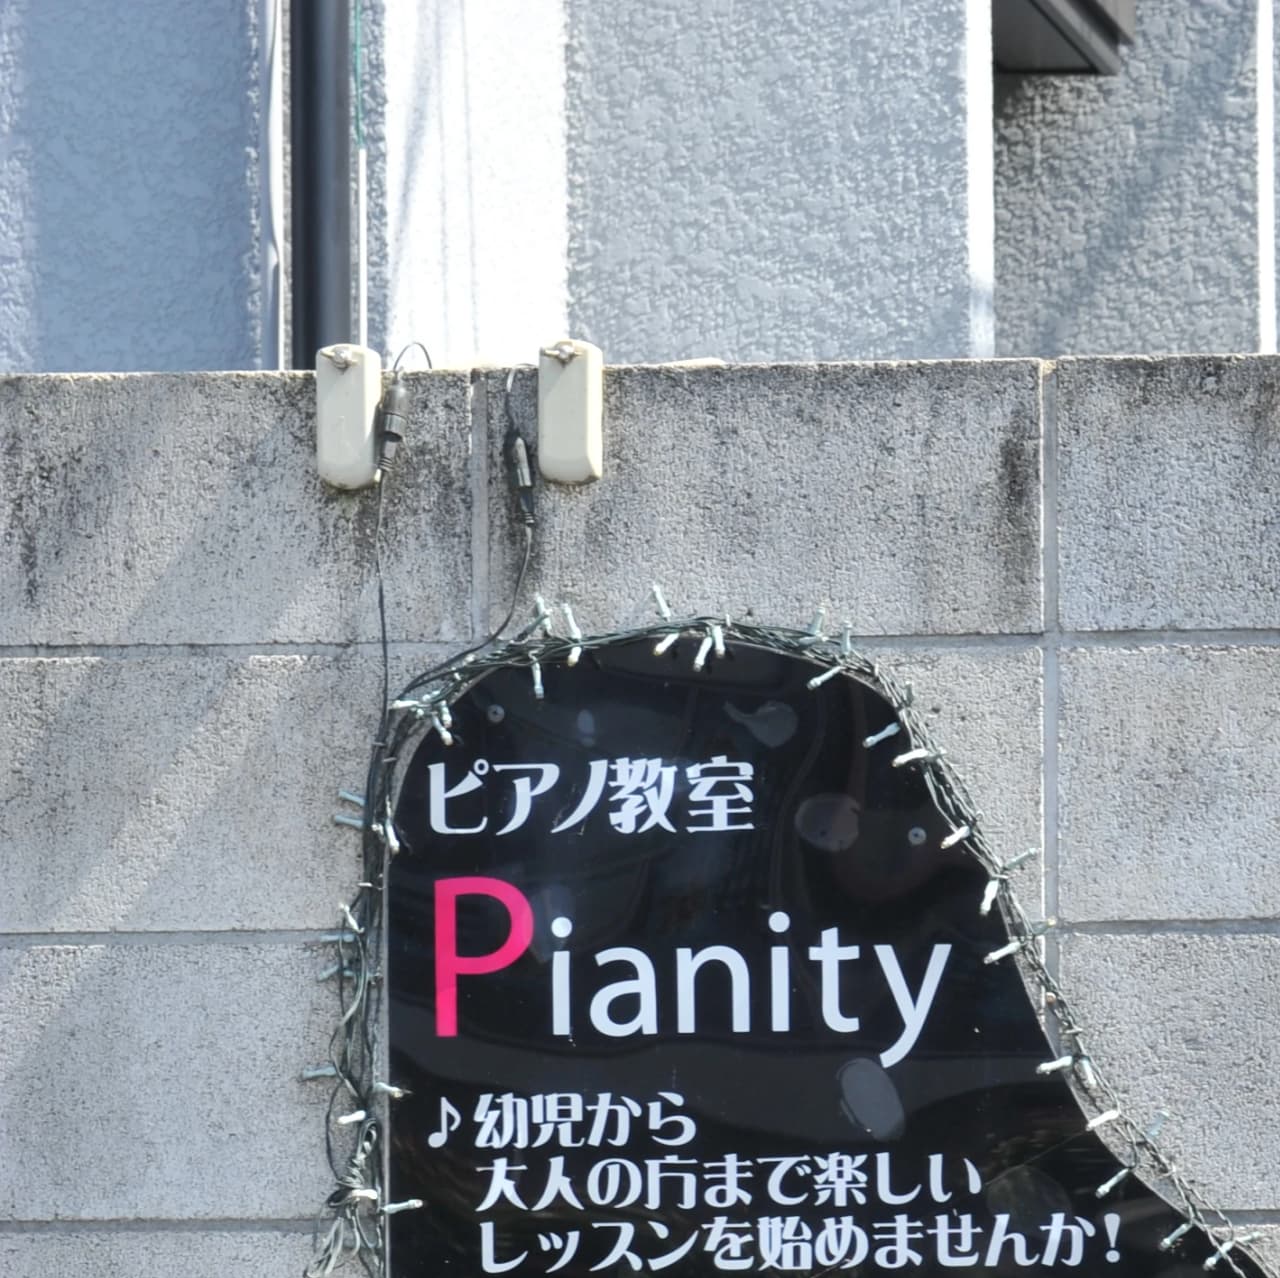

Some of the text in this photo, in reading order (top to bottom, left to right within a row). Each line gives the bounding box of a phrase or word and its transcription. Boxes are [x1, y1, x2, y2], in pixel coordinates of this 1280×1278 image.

[427, 754, 755, 836] ピアノ教室
[434, 876, 953, 1068] Pianity
[473, 1091, 697, 1150] 幼児から
[475, 1151, 982, 1212] 大人の方まで楽しい
